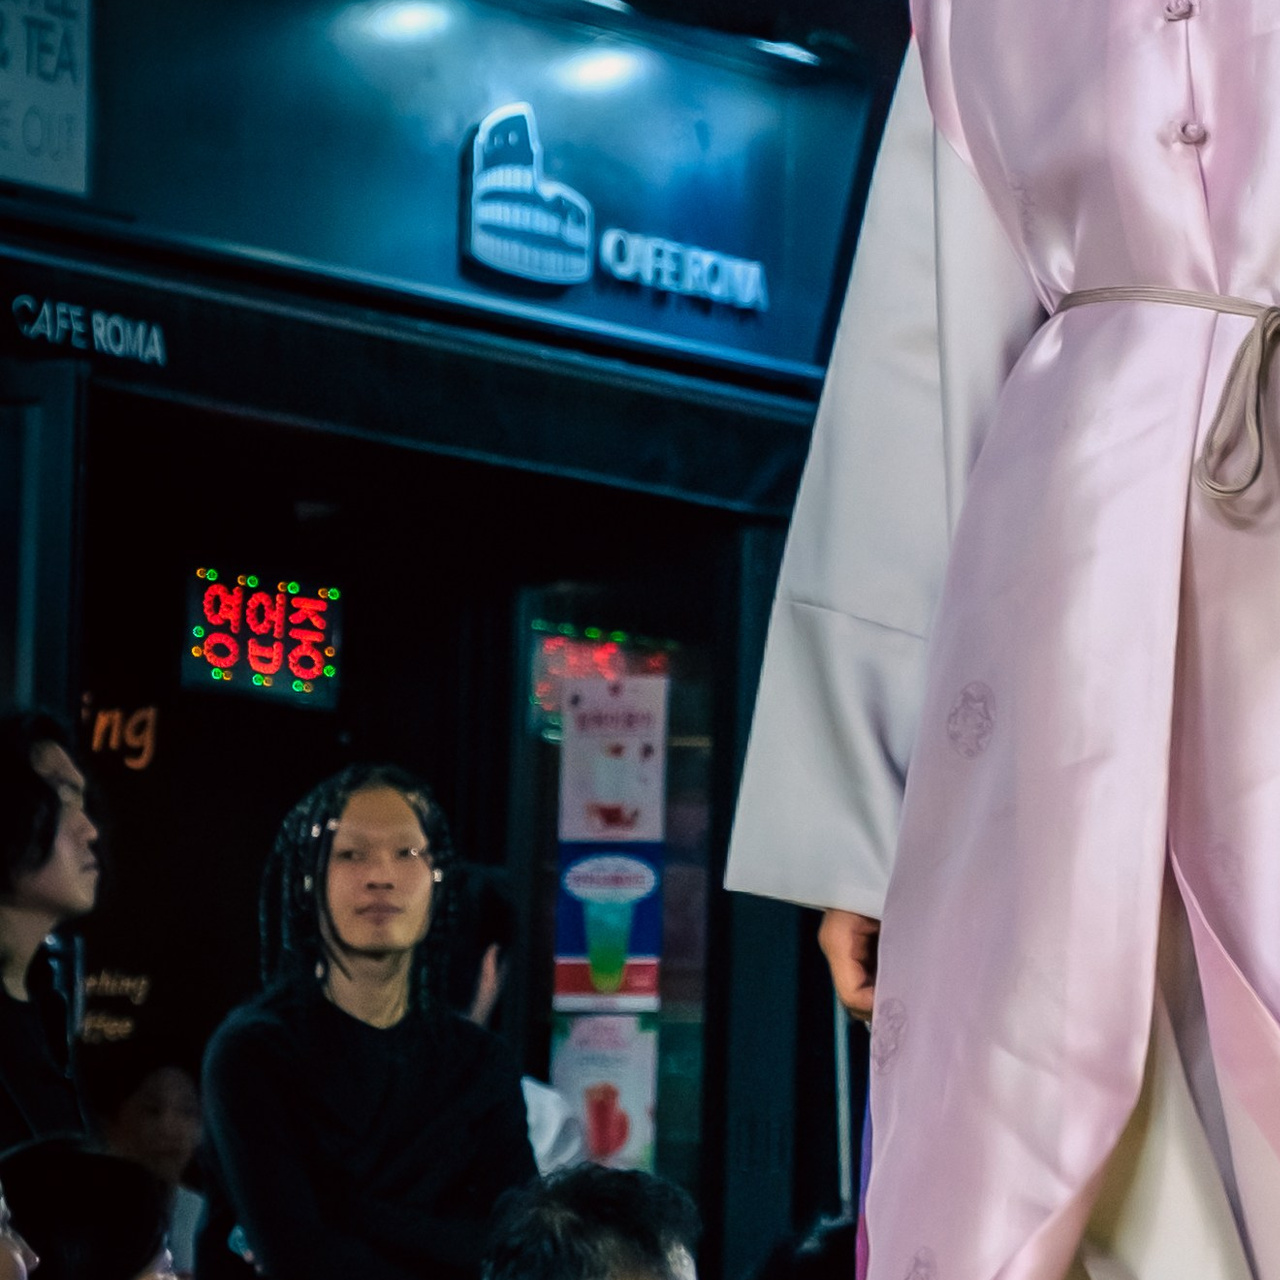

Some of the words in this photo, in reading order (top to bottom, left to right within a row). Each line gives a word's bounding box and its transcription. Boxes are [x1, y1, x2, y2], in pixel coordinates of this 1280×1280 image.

[23, 16, 78, 84] TEA
[12, 293, 88, 349] CAFE
[91, 309, 168, 367] ROMA
[203, 583, 328, 681] 영업중
